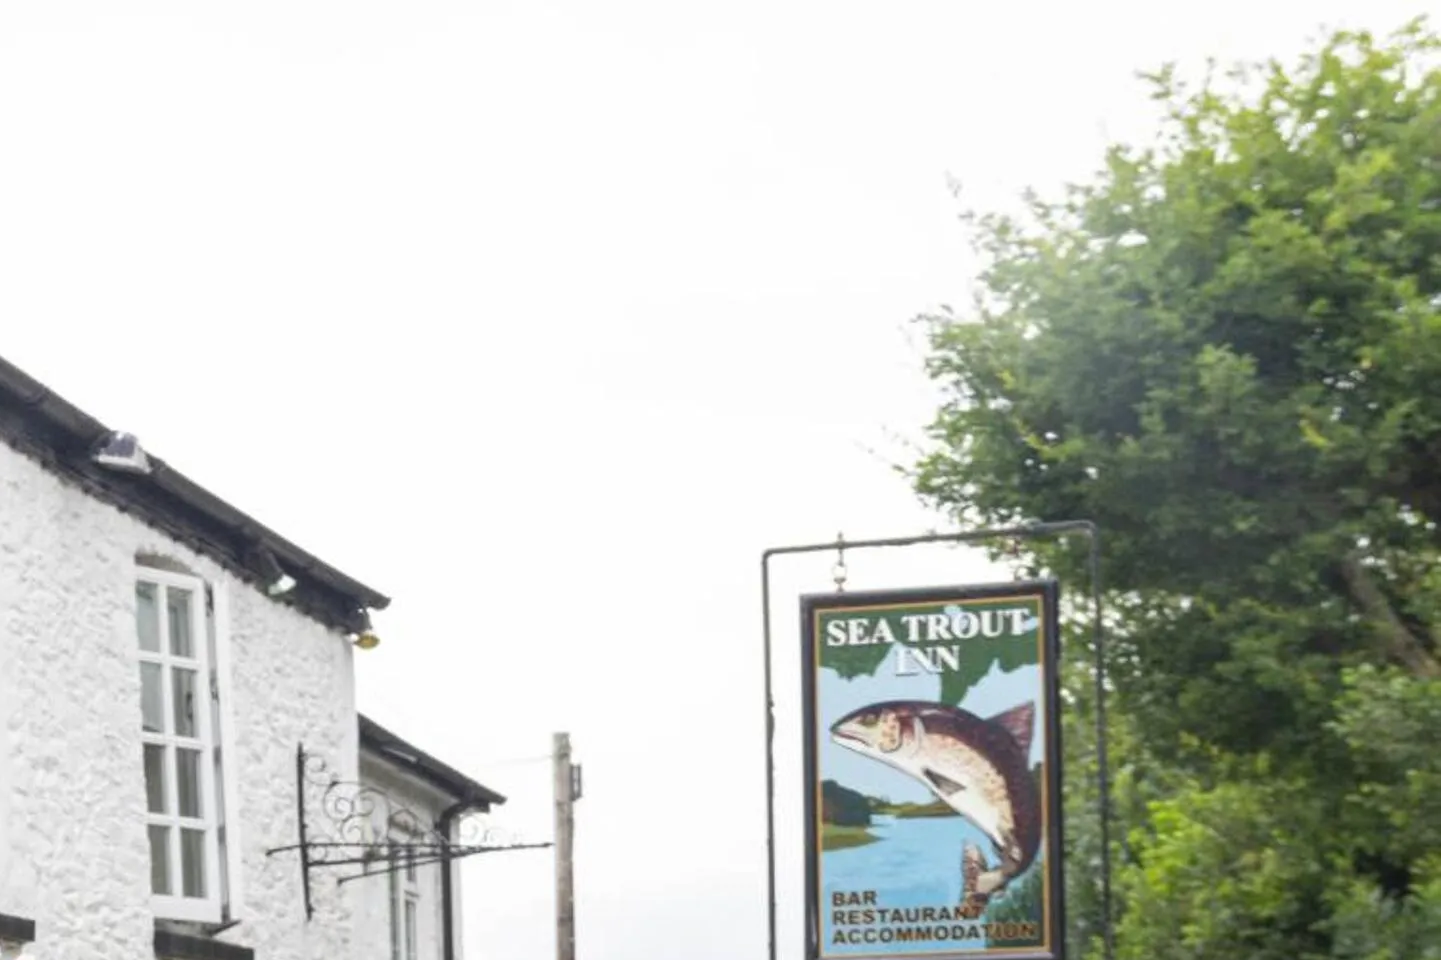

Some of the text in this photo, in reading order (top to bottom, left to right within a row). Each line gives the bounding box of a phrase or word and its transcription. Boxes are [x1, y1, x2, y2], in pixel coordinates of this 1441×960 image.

[826, 608, 1031, 646] SEA TROUT
[895, 645, 960, 676] INN
[832, 890, 878, 907] BAR
[832, 906, 985, 925] RESTAURANT
[832, 922, 1038, 944] ACCOMMODATION
